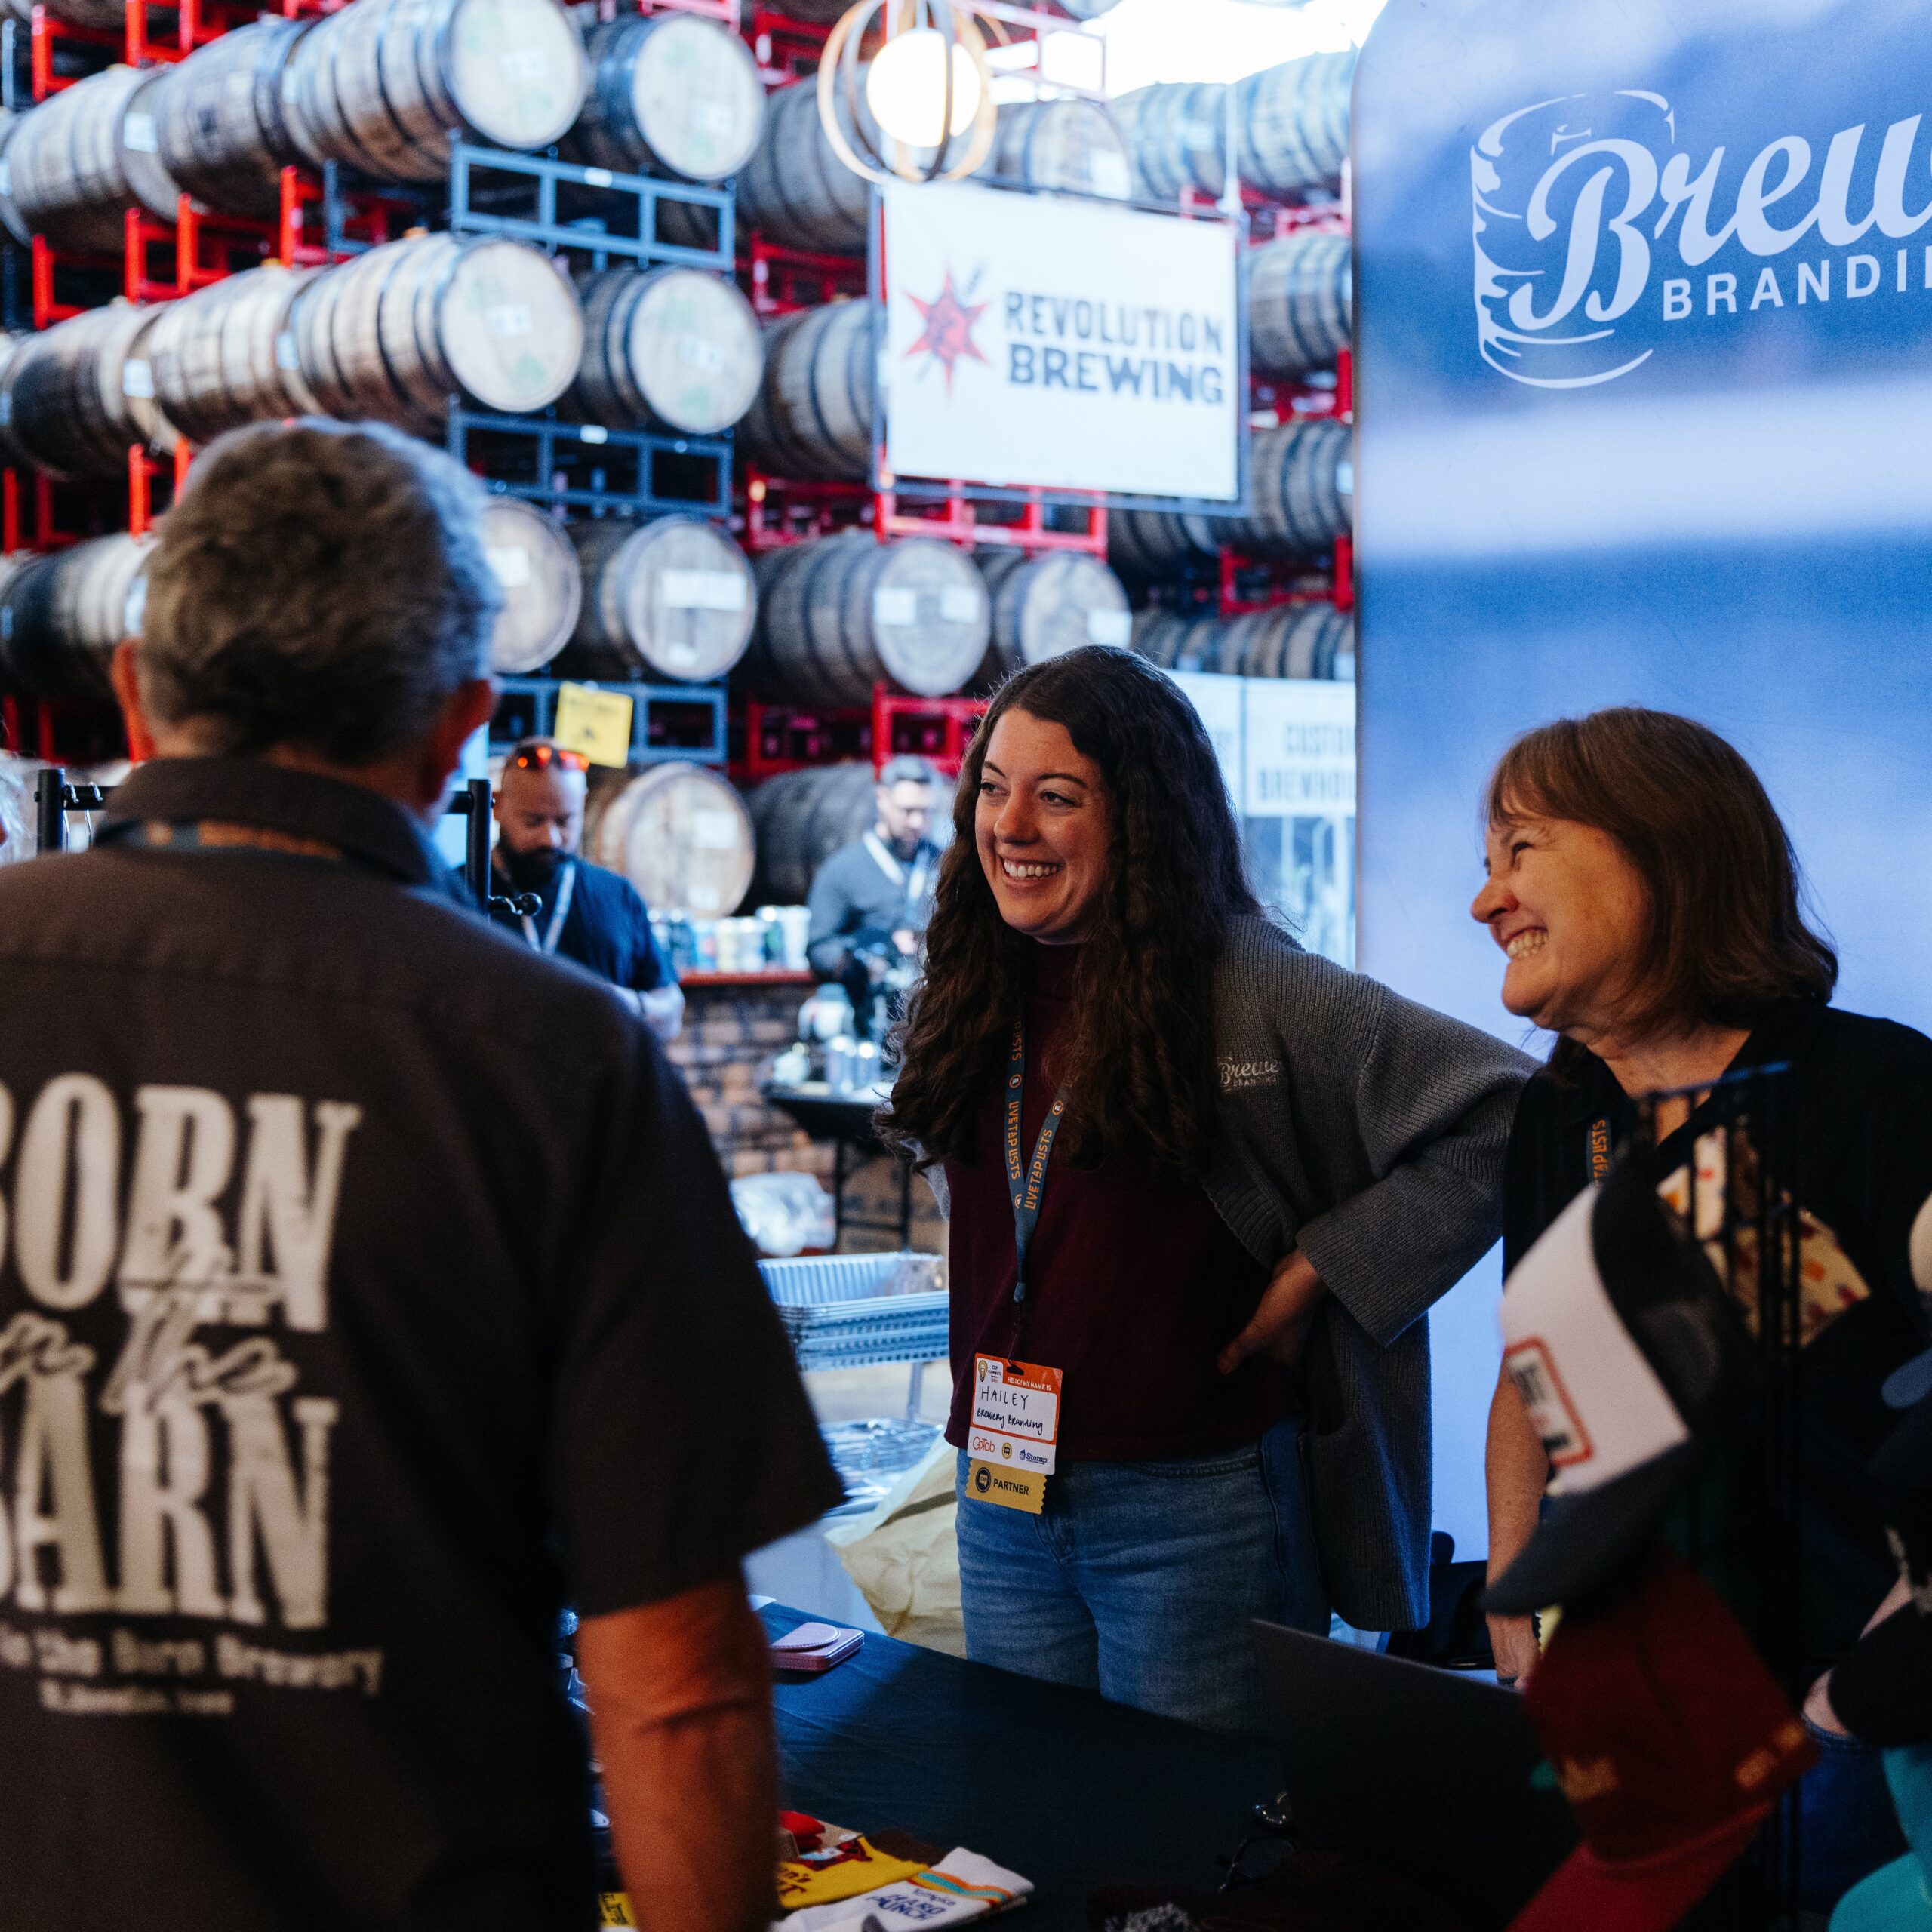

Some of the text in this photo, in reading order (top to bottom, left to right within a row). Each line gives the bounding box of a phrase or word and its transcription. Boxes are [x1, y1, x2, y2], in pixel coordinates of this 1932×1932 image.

[1005, 292, 1223, 353] REVOLUTION
[1009, 344, 1224, 404] BREWING
[1008, 1100, 1020, 1180] LIVE TAP LISTS
[1592, 1119, 1607, 1153] LISTS
[1024, 1129, 1053, 1211] LIVE TAP LISTS
[0, 1072, 363, 1334] ORN
[981, 1386, 1029, 1410] HAILEY
[1007, 1377, 1023, 1386] HELLO!
[1030, 1382, 1045, 1390] NAME
[972, 1436, 995, 1453] GoTab
[1026, 1452, 1048, 1463] Stomp
[0, 1370, 340, 1630] ARN
[993, 1478, 1029, 1495] PARTNER
